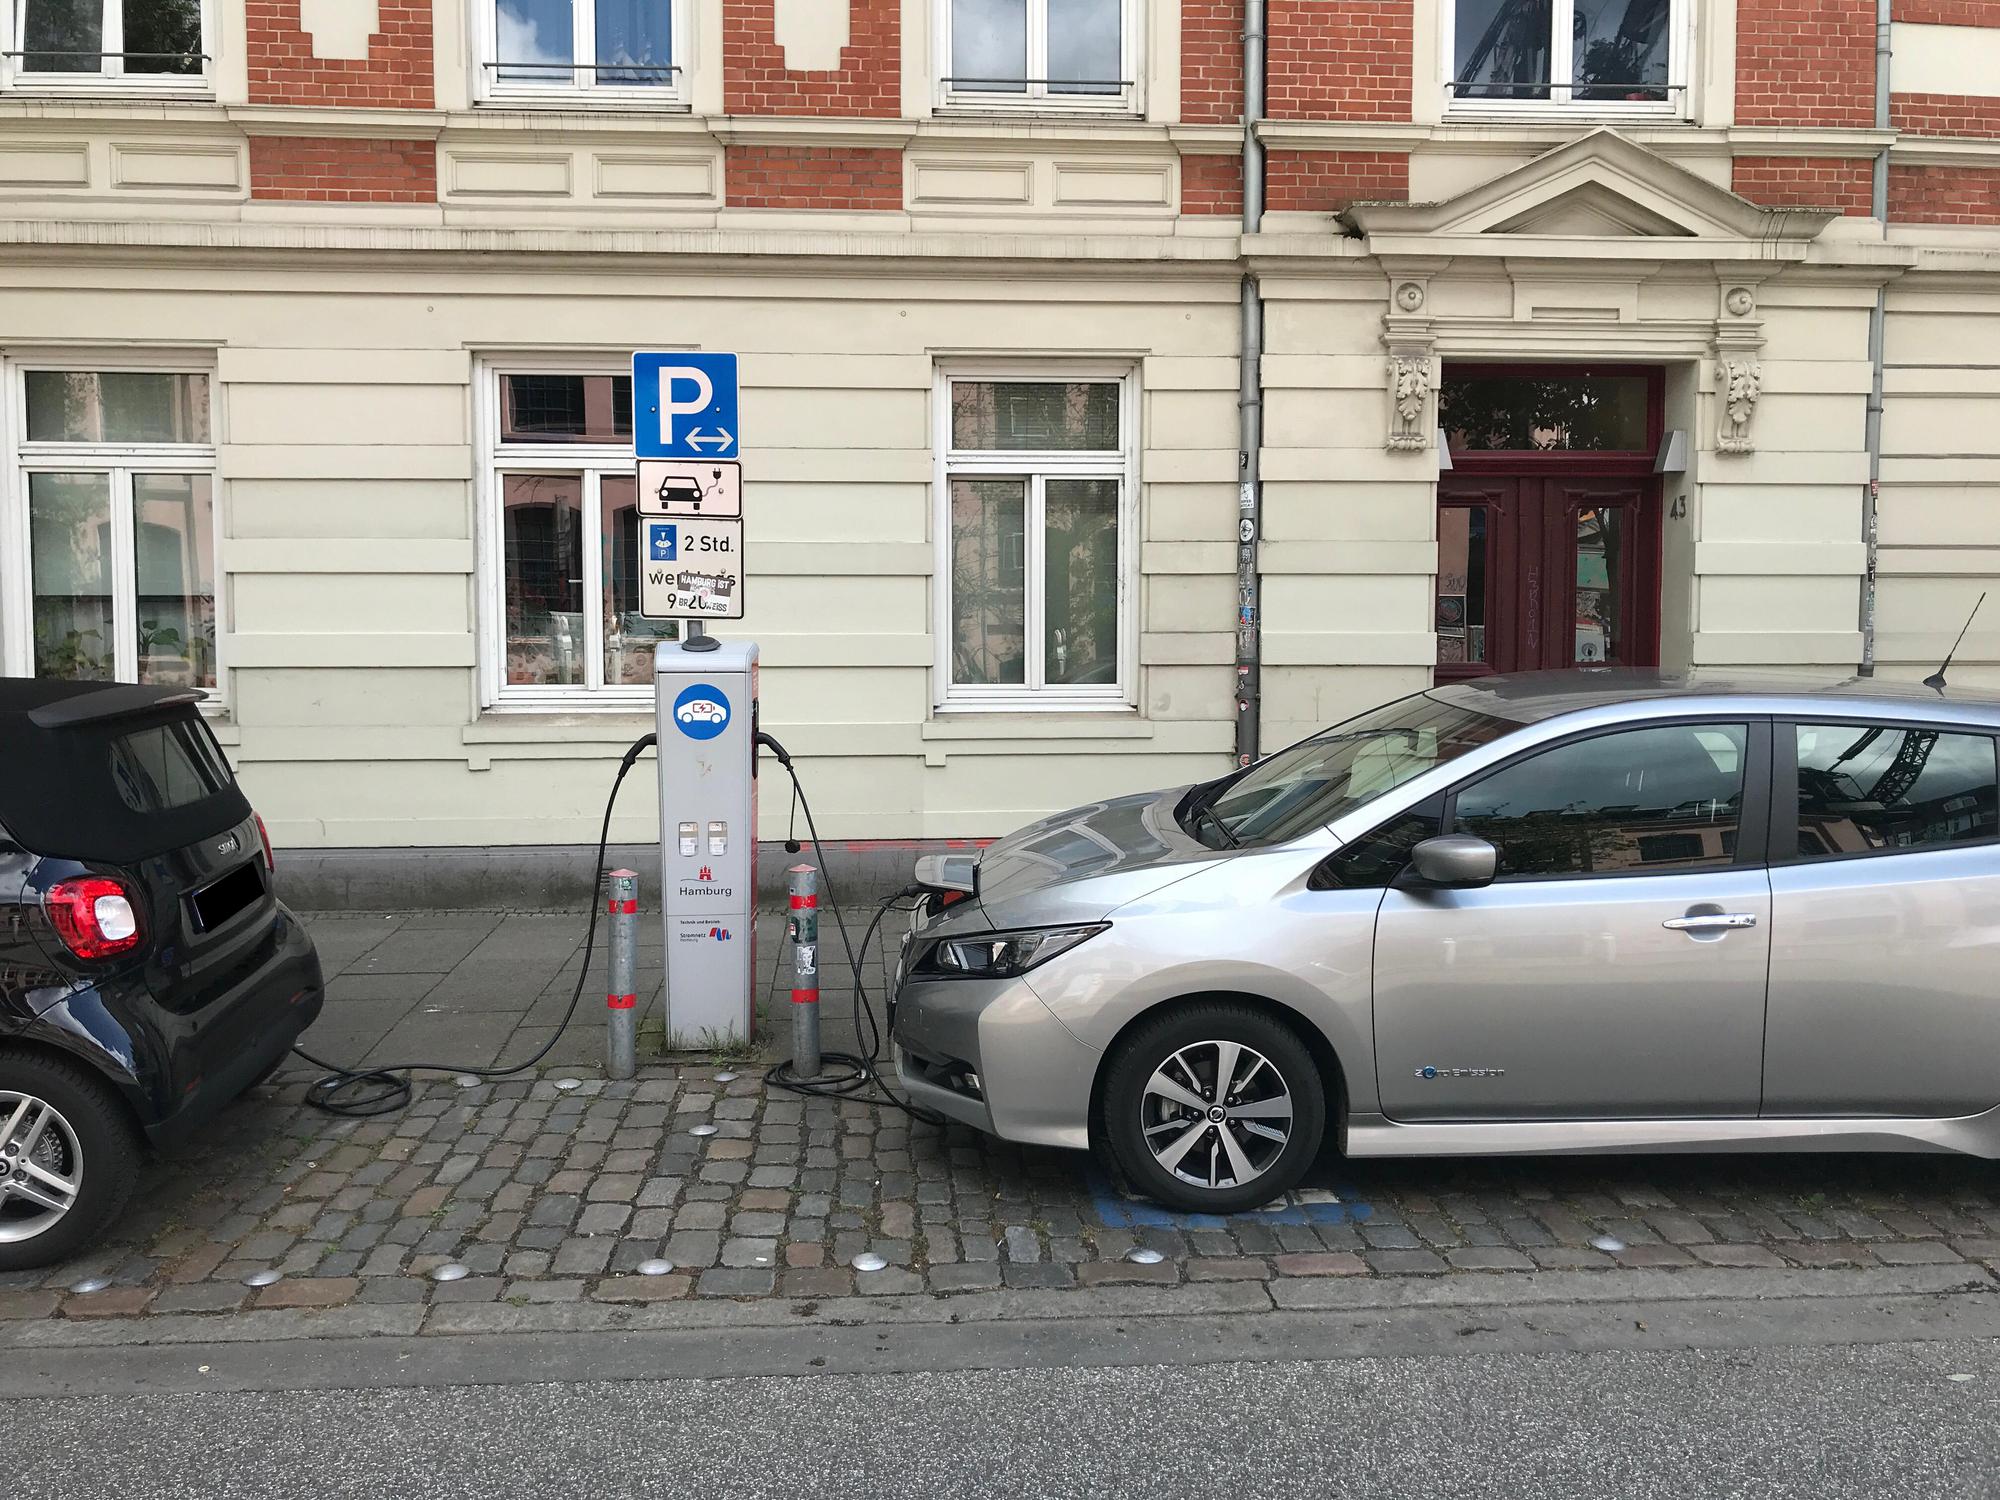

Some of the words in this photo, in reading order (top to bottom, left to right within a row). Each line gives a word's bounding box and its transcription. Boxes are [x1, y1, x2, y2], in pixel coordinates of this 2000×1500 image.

[658, 365, 714, 445] P
[1670, 495, 1687, 521] 43
[684, 535, 695, 552] 2
[699, 535, 735, 553] Std.
[681, 574, 717, 589] HAMBURG
[667, 592, 677, 609] 9
[679, 886, 732, 897] Hamburg
